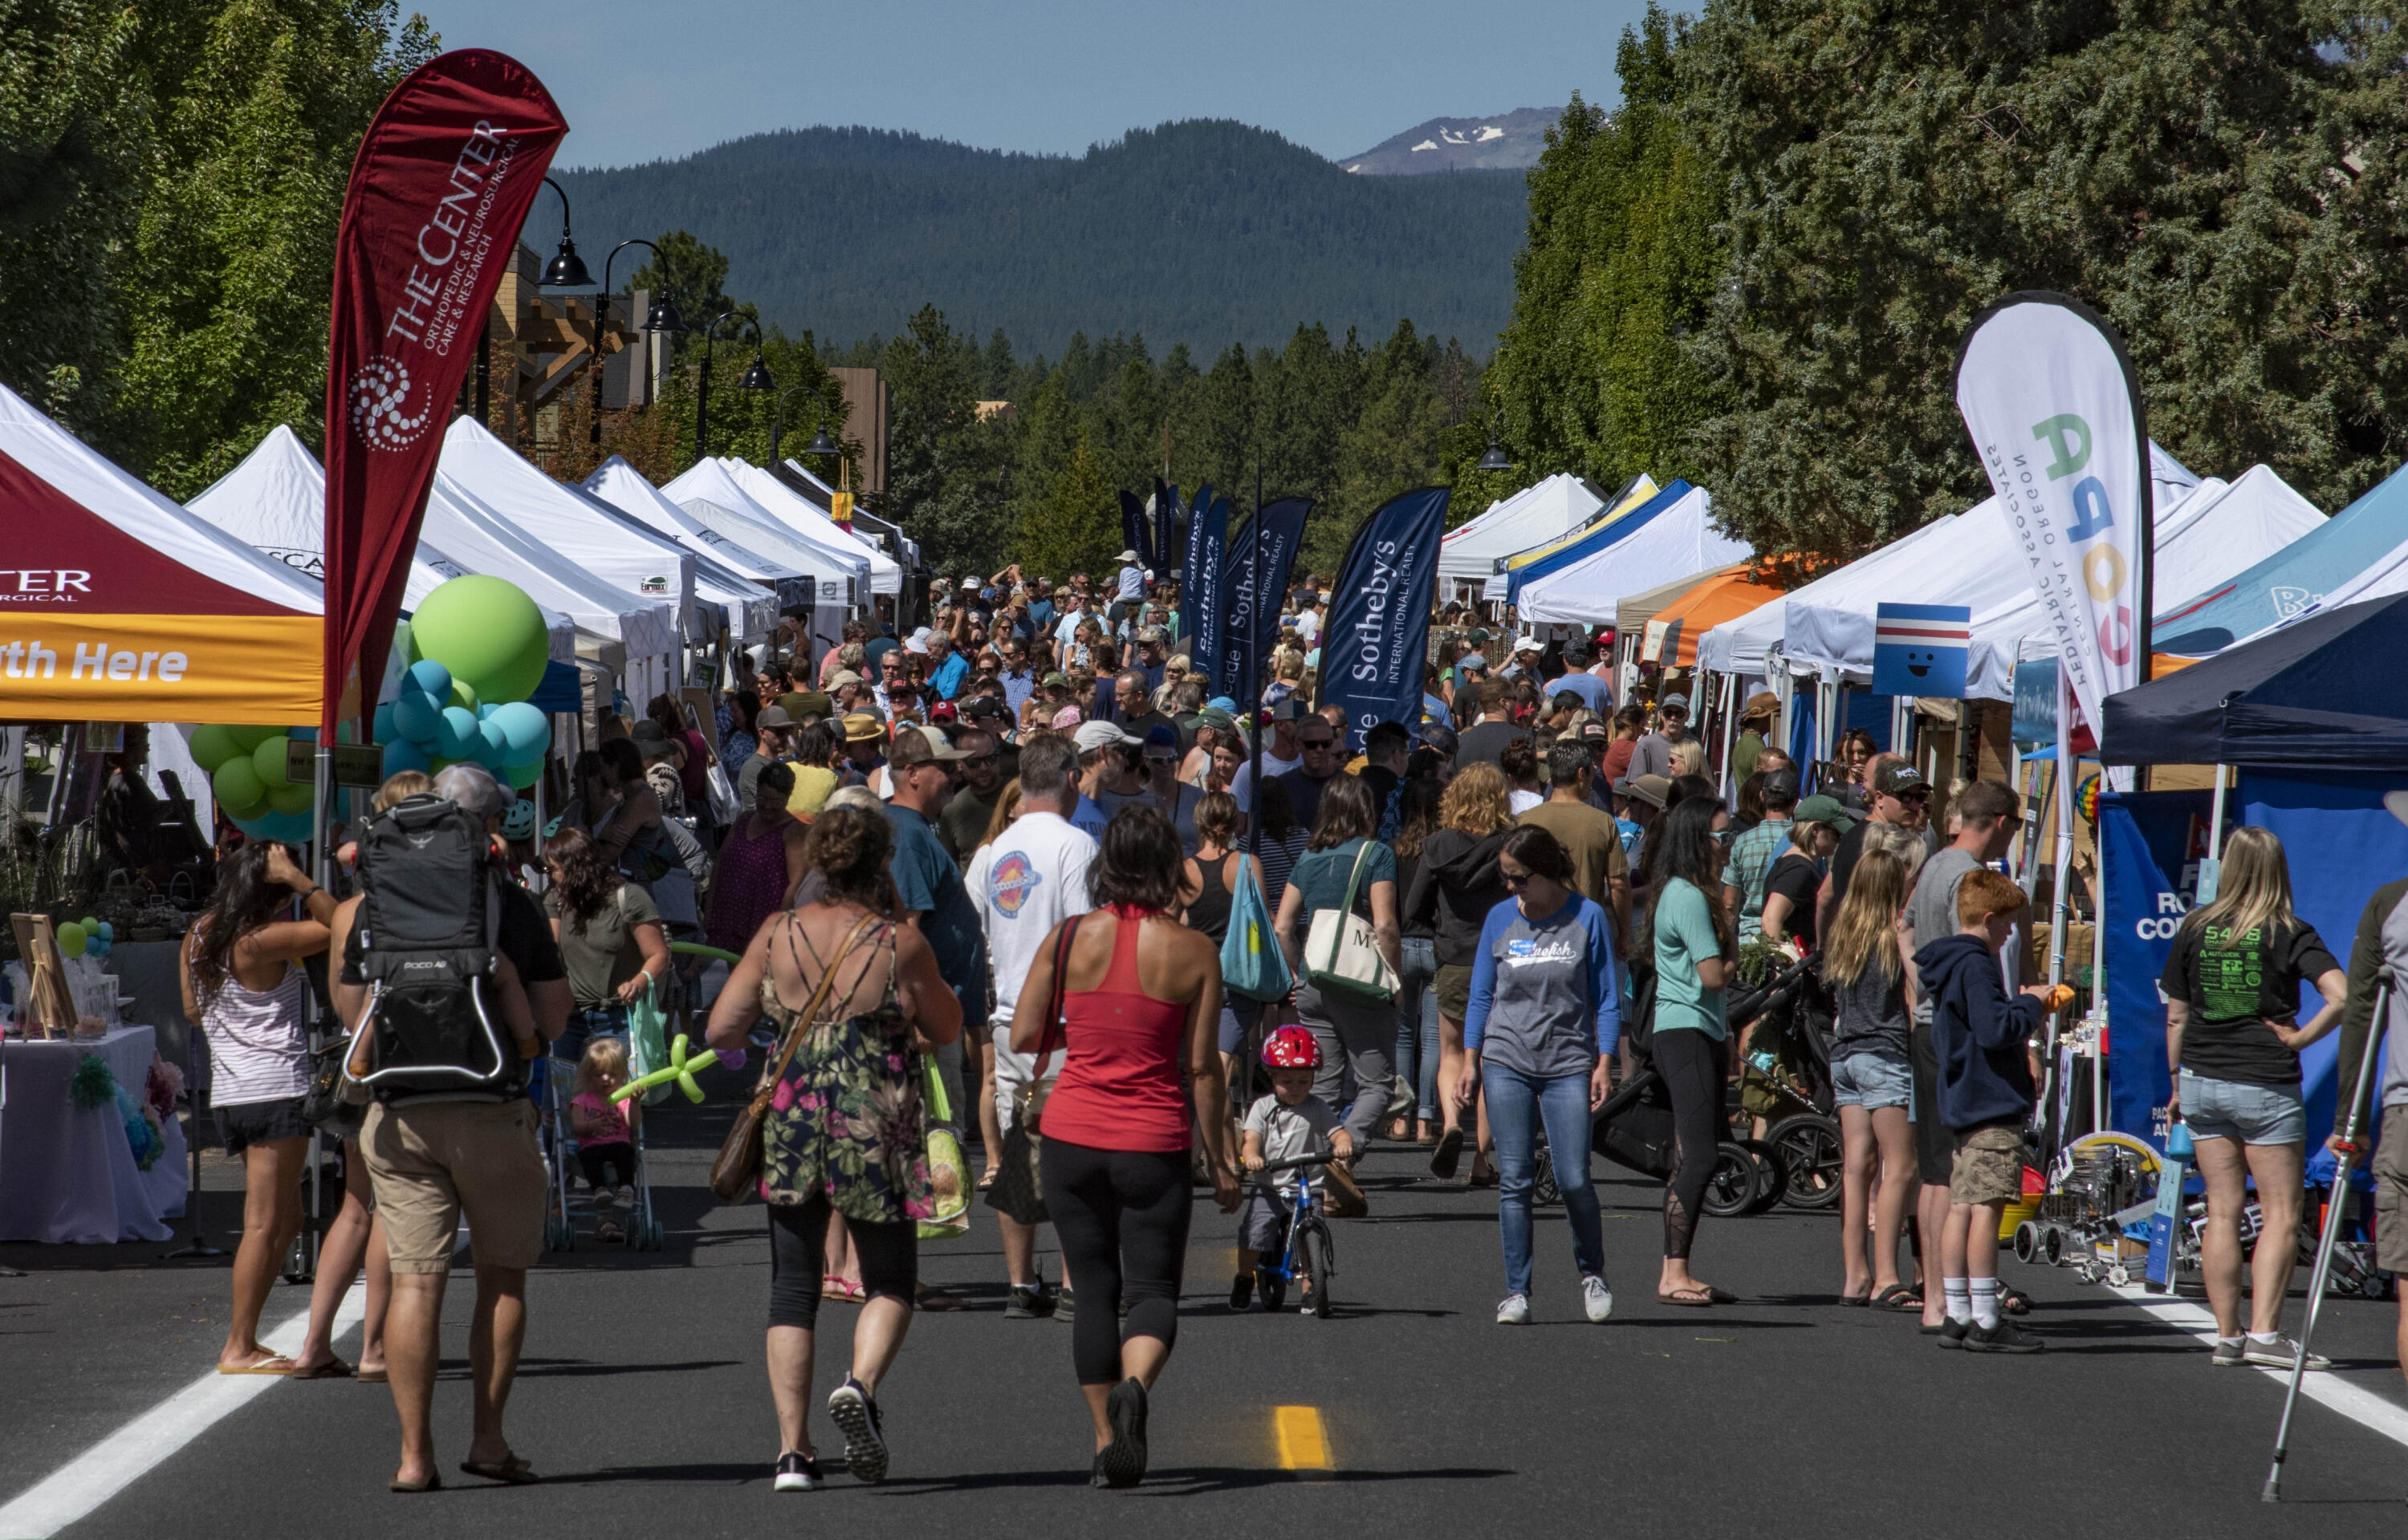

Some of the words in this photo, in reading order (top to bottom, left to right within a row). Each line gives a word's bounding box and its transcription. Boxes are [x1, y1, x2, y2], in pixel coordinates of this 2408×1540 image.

[464, 137, 521, 248] NEUROSURGICAL
[386, 264, 441, 343] THE
[417, 120, 508, 266] CENTER
[456, 234, 493, 306] RESEARCH
[460, 250, 472, 261] &
[424, 261, 466, 350] ORTHOPEDIC
[451, 308, 464, 319] &
[437, 320, 458, 356] CARE
[1270, 533, 1284, 564] REALTY
[1352, 540, 1397, 681] Sotheby's
[1389, 588, 1409, 684] INTERNATIONAL
[1400, 544, 1416, 586] REALTY
[71, 642, 189, 682] Here
[1224, 650, 1241, 694] cade
[1352, 929, 1369, 948] M
[2204, 926, 2261, 941] 548
